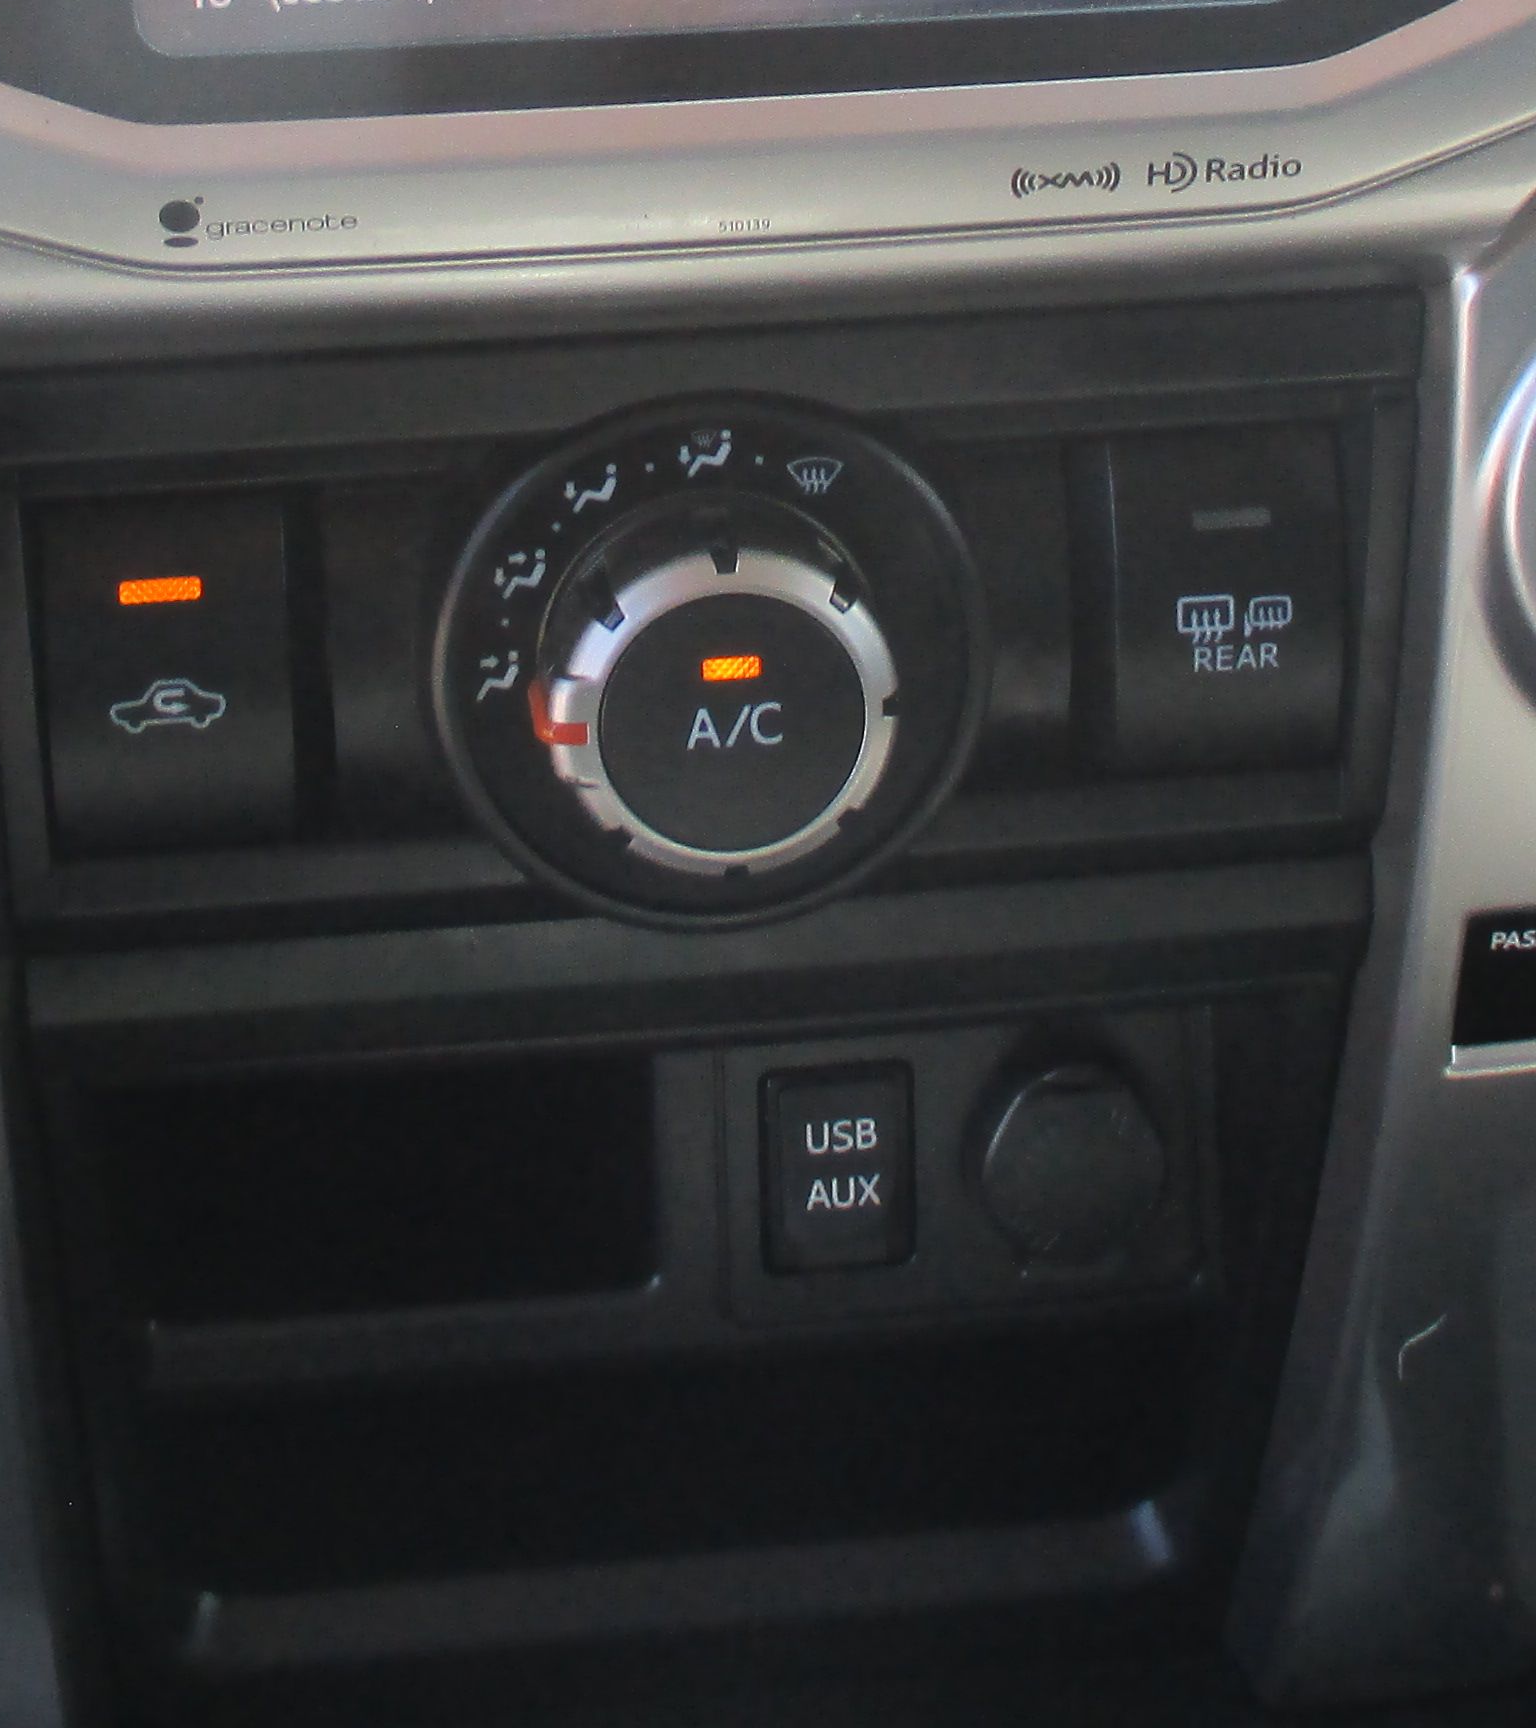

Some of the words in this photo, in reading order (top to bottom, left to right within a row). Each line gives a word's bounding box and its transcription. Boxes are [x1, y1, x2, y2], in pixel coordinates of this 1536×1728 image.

[1205, 153, 1303, 184] Radio
[205, 213, 358, 242] gracenote
[1193, 643, 1280, 674] REAR
[686, 700, 785, 752] A/C
[805, 1117, 878, 1155] USB
[806, 1173, 882, 1211] AUX
